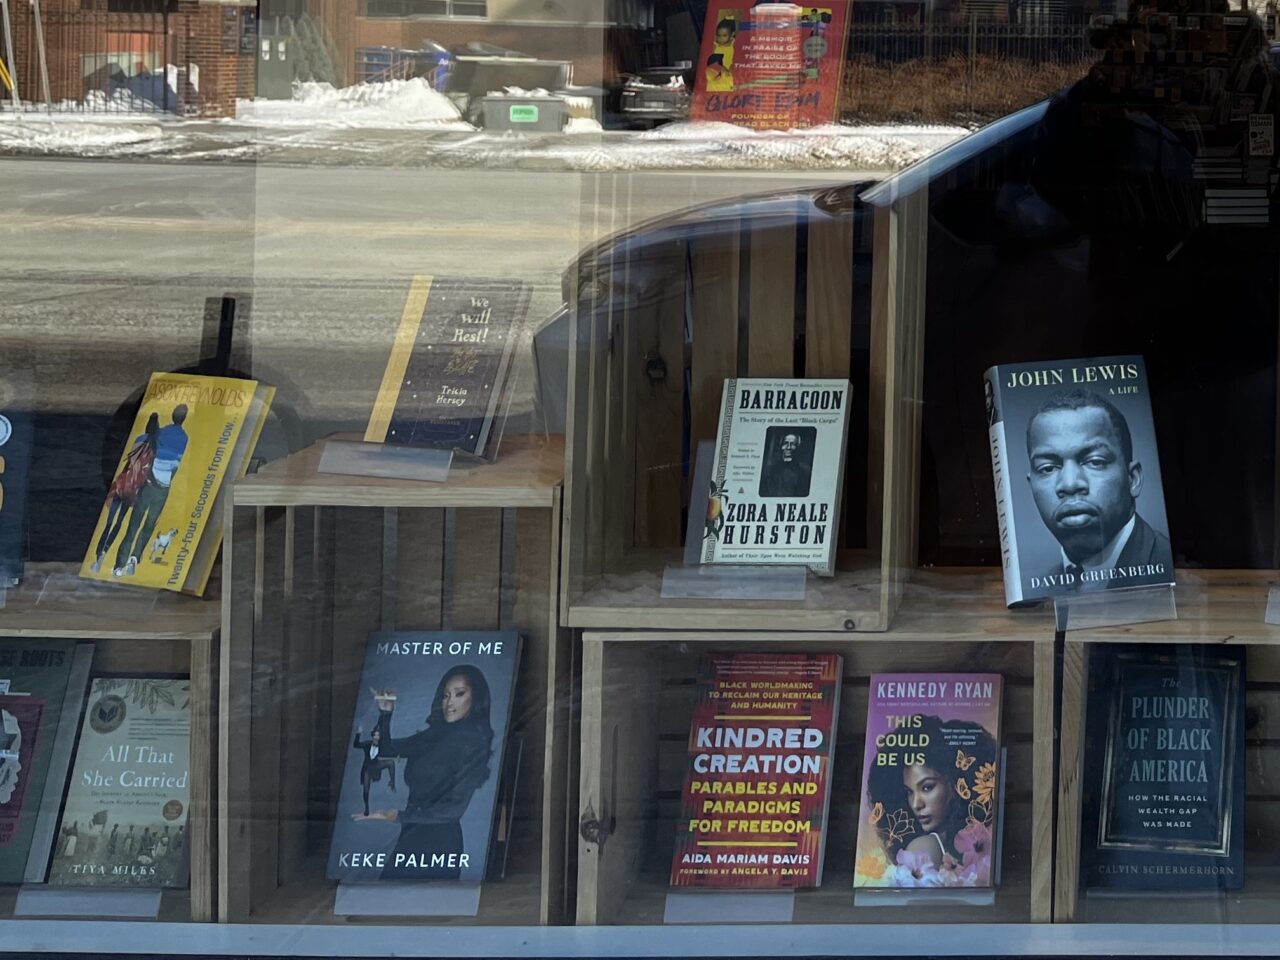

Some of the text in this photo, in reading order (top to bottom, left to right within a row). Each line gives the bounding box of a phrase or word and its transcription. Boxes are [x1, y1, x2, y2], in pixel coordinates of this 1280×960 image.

[461, 307, 493, 325] will
[1007, 363, 1139, 388] JOHN LEWIS
[1108, 386, 1139, 395] A LIFE
[739, 389, 844, 410] BARRACOON
[190, 444, 226, 525] Seconds from
[726, 503, 829, 523] ZORA NEALE
[722, 525, 827, 544] HURSTON
[1031, 563, 1166, 589] DAVID GREENBERG
[376, 641, 504, 656] MASTER OF ME
[719, 681, 747, 689] BLACK
[877, 682, 993, 699] KENNEDY RYAN
[1161, 678, 1182, 688] The
[708, 691, 720, 699] TO
[722, 691, 760, 699] RECLAIM
[782, 692, 823, 700] HERITAGE
[1131, 697, 1210, 719] PLUNDER
[885, 715, 922, 728] THIS
[696, 727, 824, 749] KINDRED
[875, 734, 930, 748] COULD
[1127, 728, 1212, 751] OF BLACK
[102, 745, 175, 764] All That
[876, 752, 926, 766] BE US
[693, 754, 821, 774] CREATION
[1129, 759, 1209, 783] AMERICA
[81, 770, 189, 789] She Carried
[690, 781, 818, 795] PARABLES AND
[1128, 794, 1149, 802] HOW
[1152, 794, 1170, 802] THE
[702, 801, 801, 814] PARADIGMS
[1138, 807, 1198, 815] WEALTH GAP
[688, 819, 811, 833] FOR FREEDOM
[1142, 820, 1163, 828] WAS
[338, 852, 471, 869] KEKE PALMER
[682, 853, 810, 865] AIDA MARIAM DAVIS
[731, 867, 769, 876] ANGELA
[780, 868, 809, 876] DAVIS
[1098, 864, 1235, 876] CALVIN SCHERMERHORN
